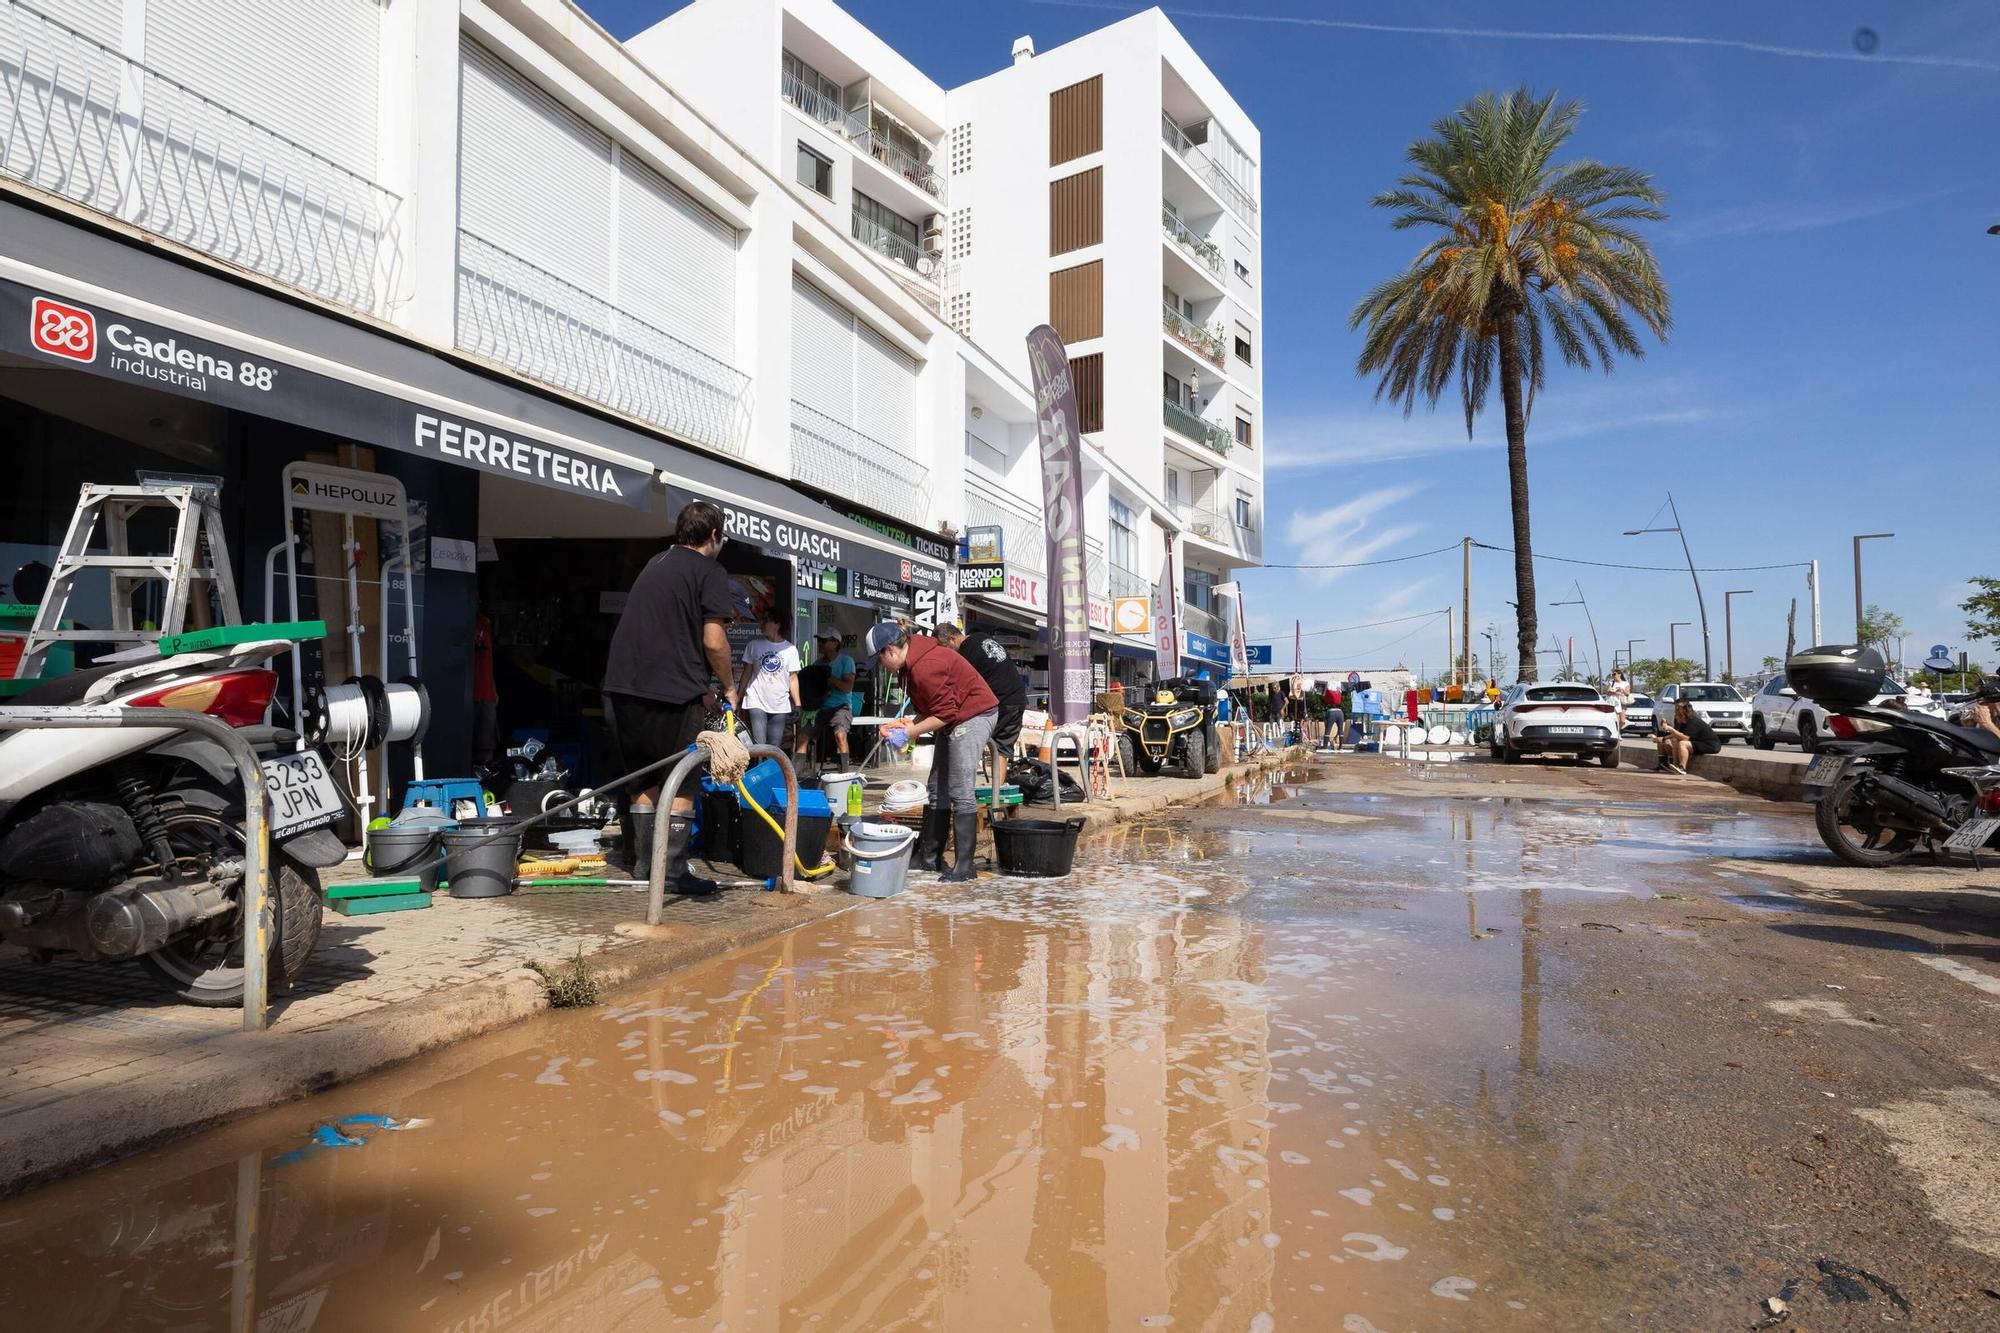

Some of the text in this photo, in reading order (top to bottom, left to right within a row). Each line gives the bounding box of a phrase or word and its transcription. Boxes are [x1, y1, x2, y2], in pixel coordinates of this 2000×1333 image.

[106, 323, 274, 391] Cadena 88
[110, 352, 207, 392] industrial
[414, 412, 623, 497] FERRETERIA
[315, 482, 397, 507] HEPOLUZ
[722, 507, 841, 562] RRES GUASCH
[915, 536, 950, 560] TICKETS
[863, 574, 878, 586] Boats
[881, 578, 898, 592] Yachts
[912, 564, 933, 581] Cadena
[960, 568, 1003, 579] MONDO
[960, 578, 990, 589] RENT
[1008, 574, 1027, 601] ESO
[915, 590, 936, 637] AR
[262, 756, 322, 791] 5233
[282, 785, 323, 818] JPN
[281, 826, 297, 837] Can
[302, 815, 331, 831] Manolo
